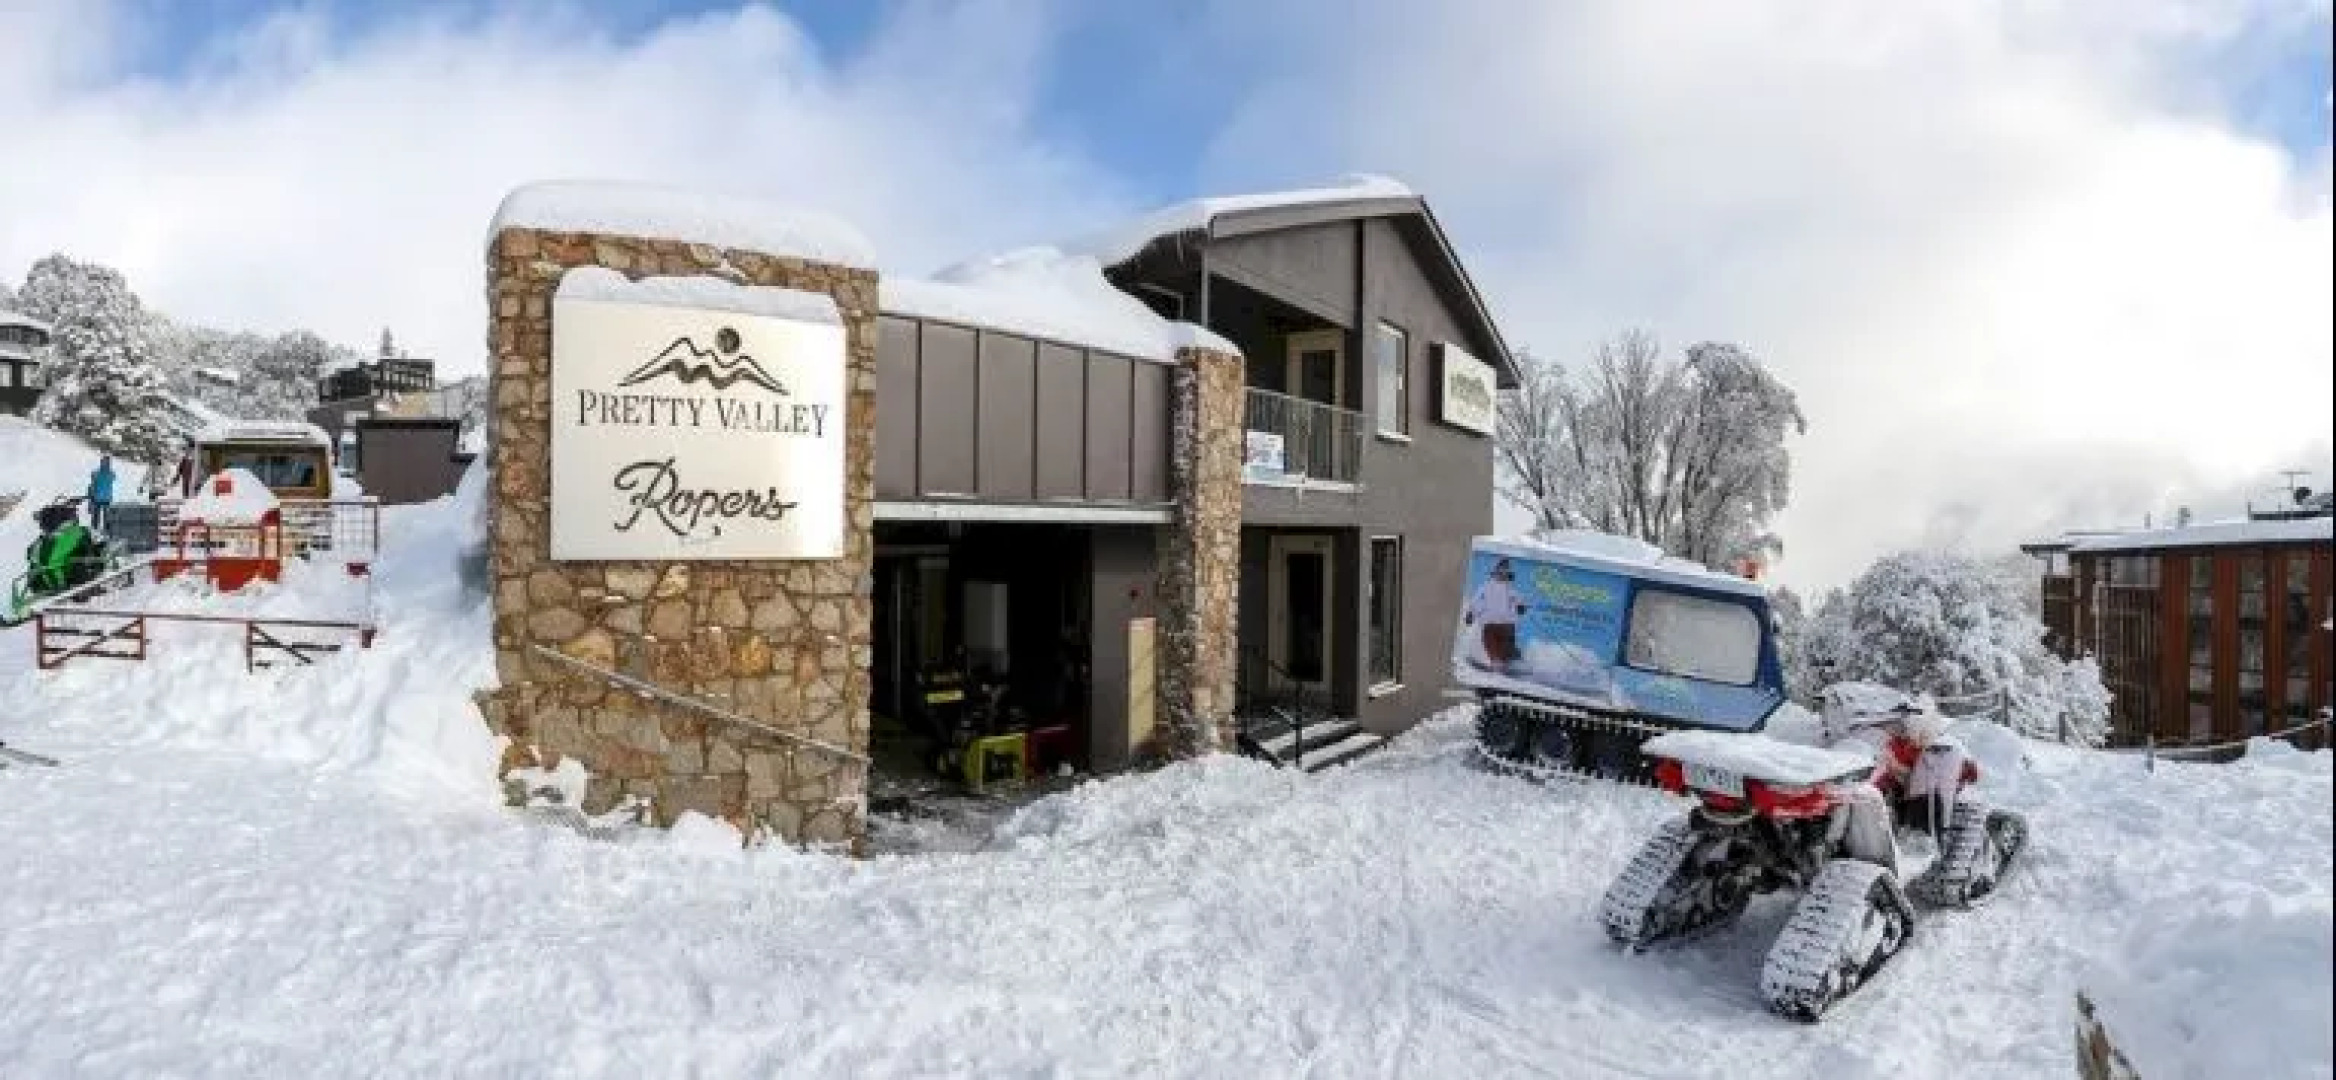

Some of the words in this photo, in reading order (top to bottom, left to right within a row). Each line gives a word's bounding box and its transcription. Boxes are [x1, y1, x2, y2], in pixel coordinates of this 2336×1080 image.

[577, 389, 704, 427] PRETTY
[714, 397, 828, 438] VALLEY
[614, 456, 799, 536] Ropers
